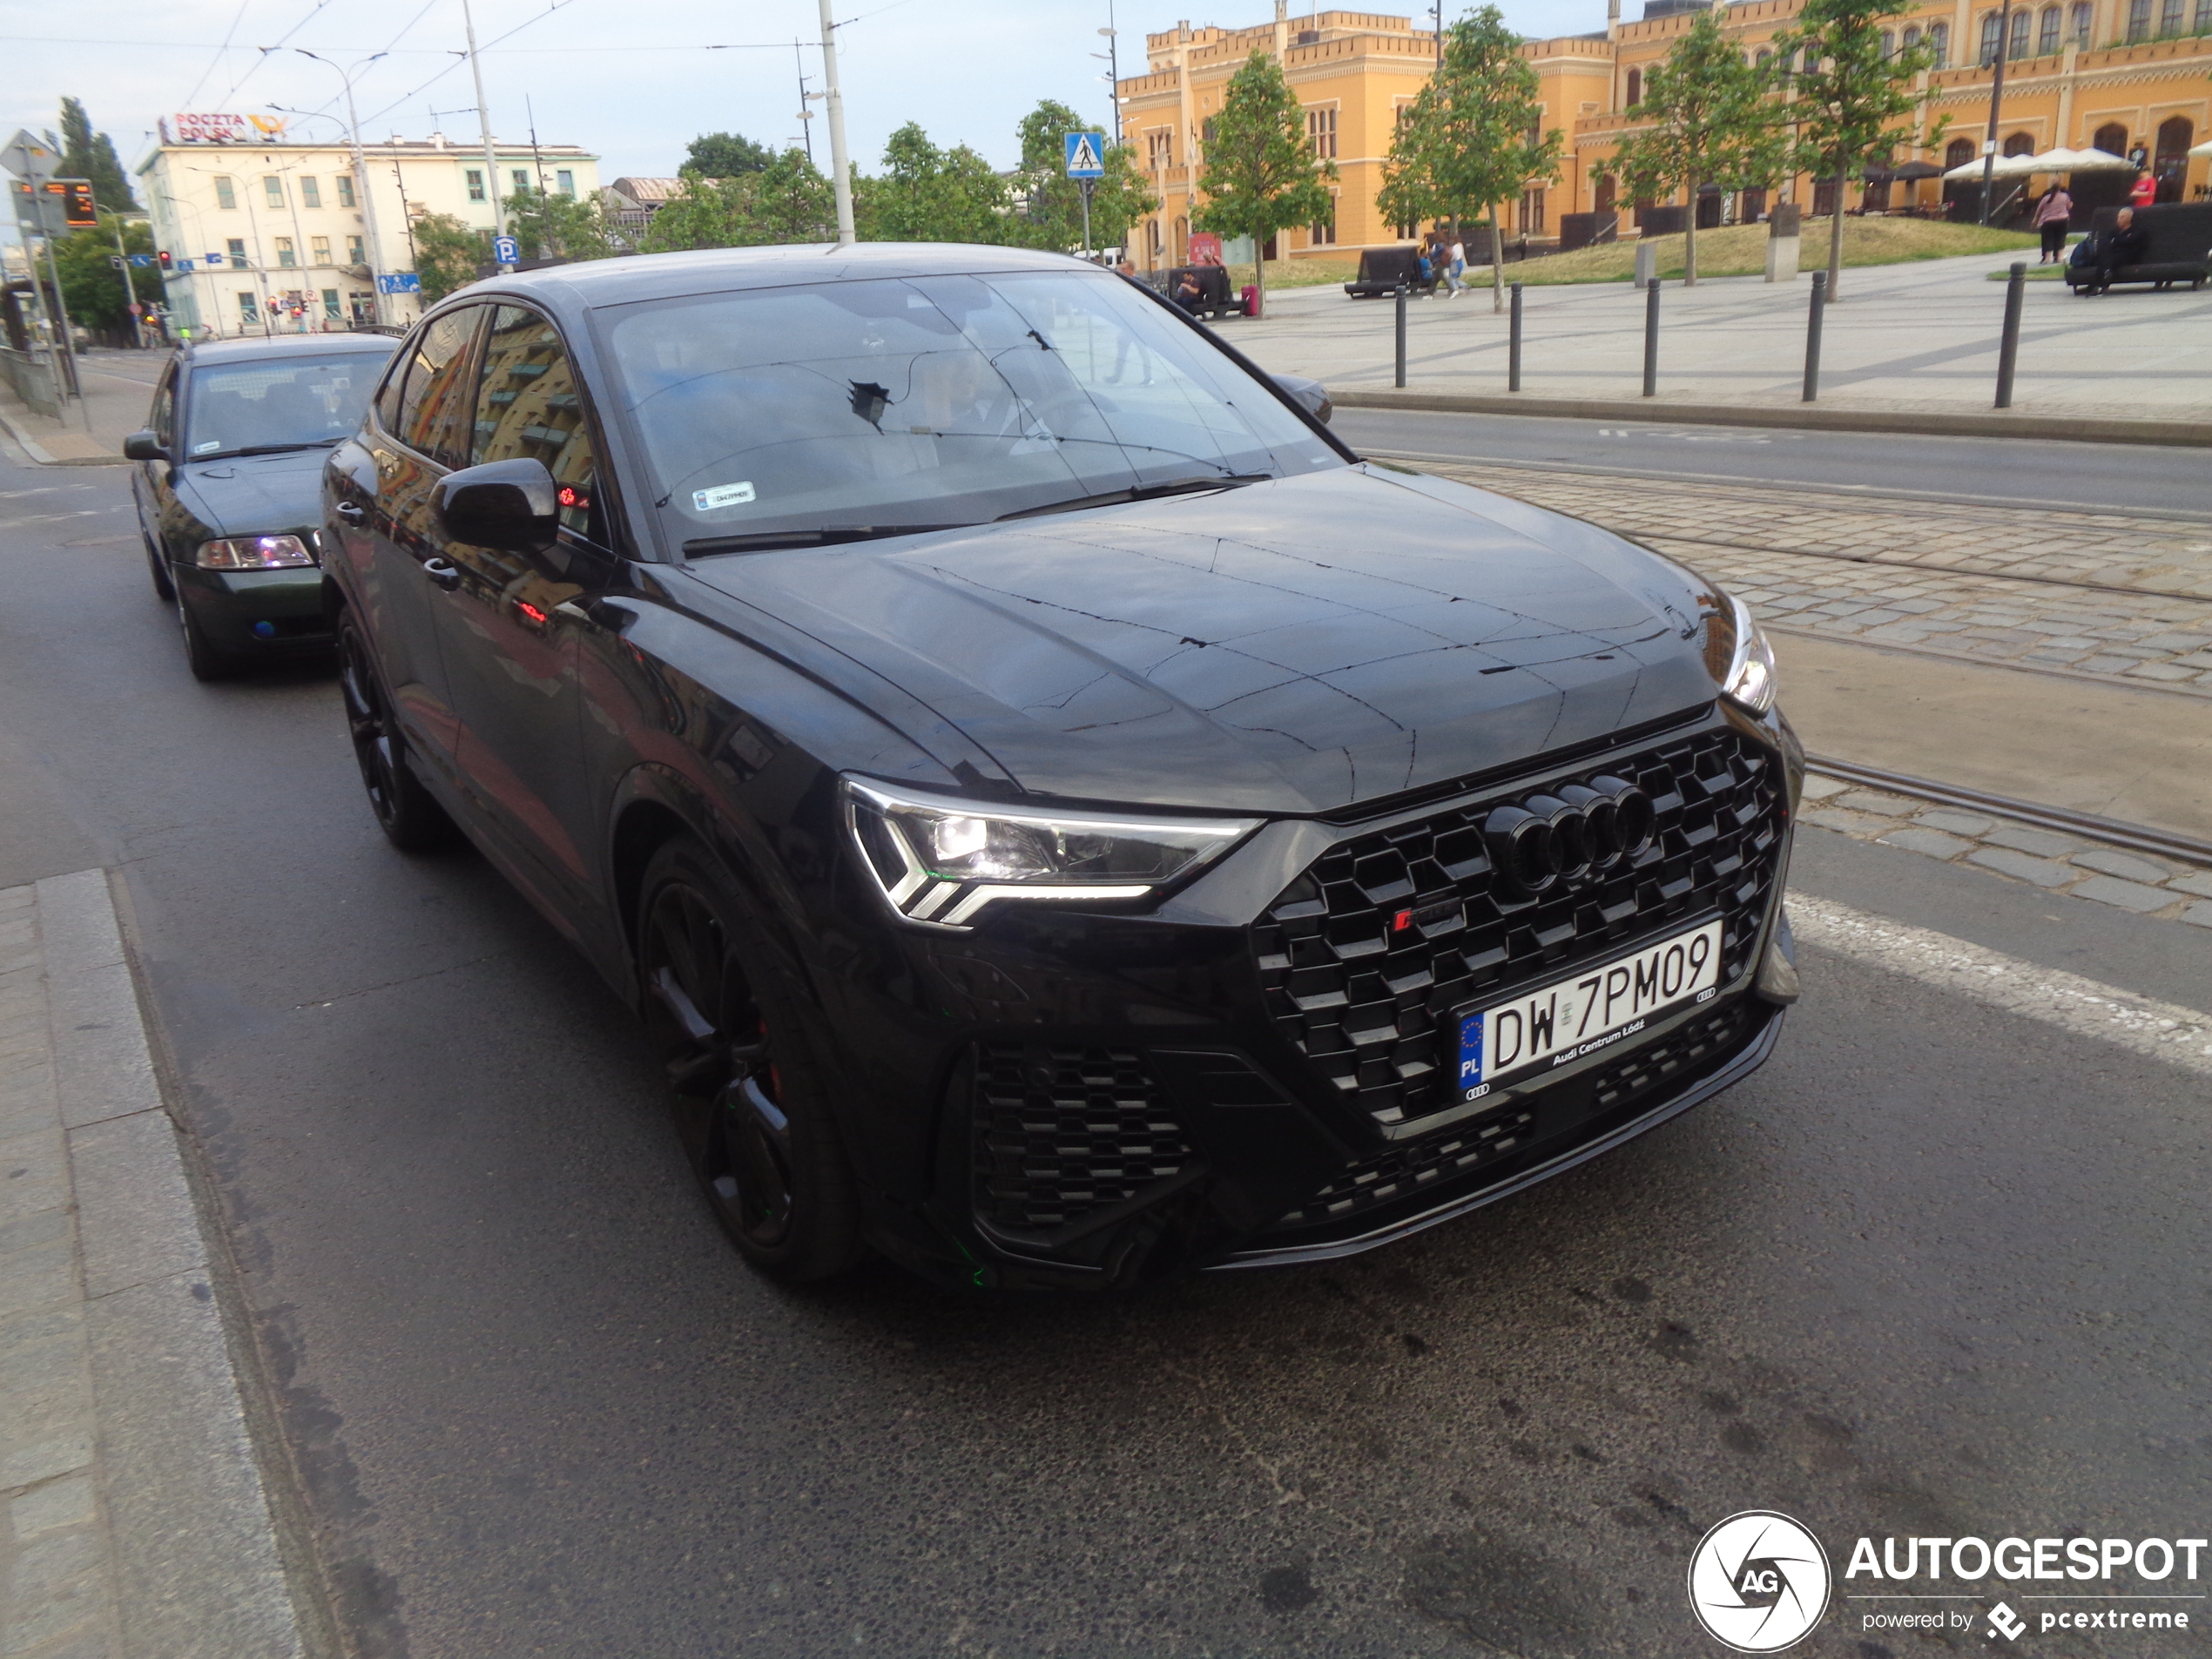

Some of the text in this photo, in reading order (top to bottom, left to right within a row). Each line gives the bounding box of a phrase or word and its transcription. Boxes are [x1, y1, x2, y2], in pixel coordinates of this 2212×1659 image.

[175, 113, 246, 125] POCZTA
[500, 243, 514, 260] P
[1494, 933, 1710, 1071] DW 7PM09
[1553, 1018, 1646, 1067] Audi Centrum Łódź
[1460, 1058, 1480, 1078] PL
